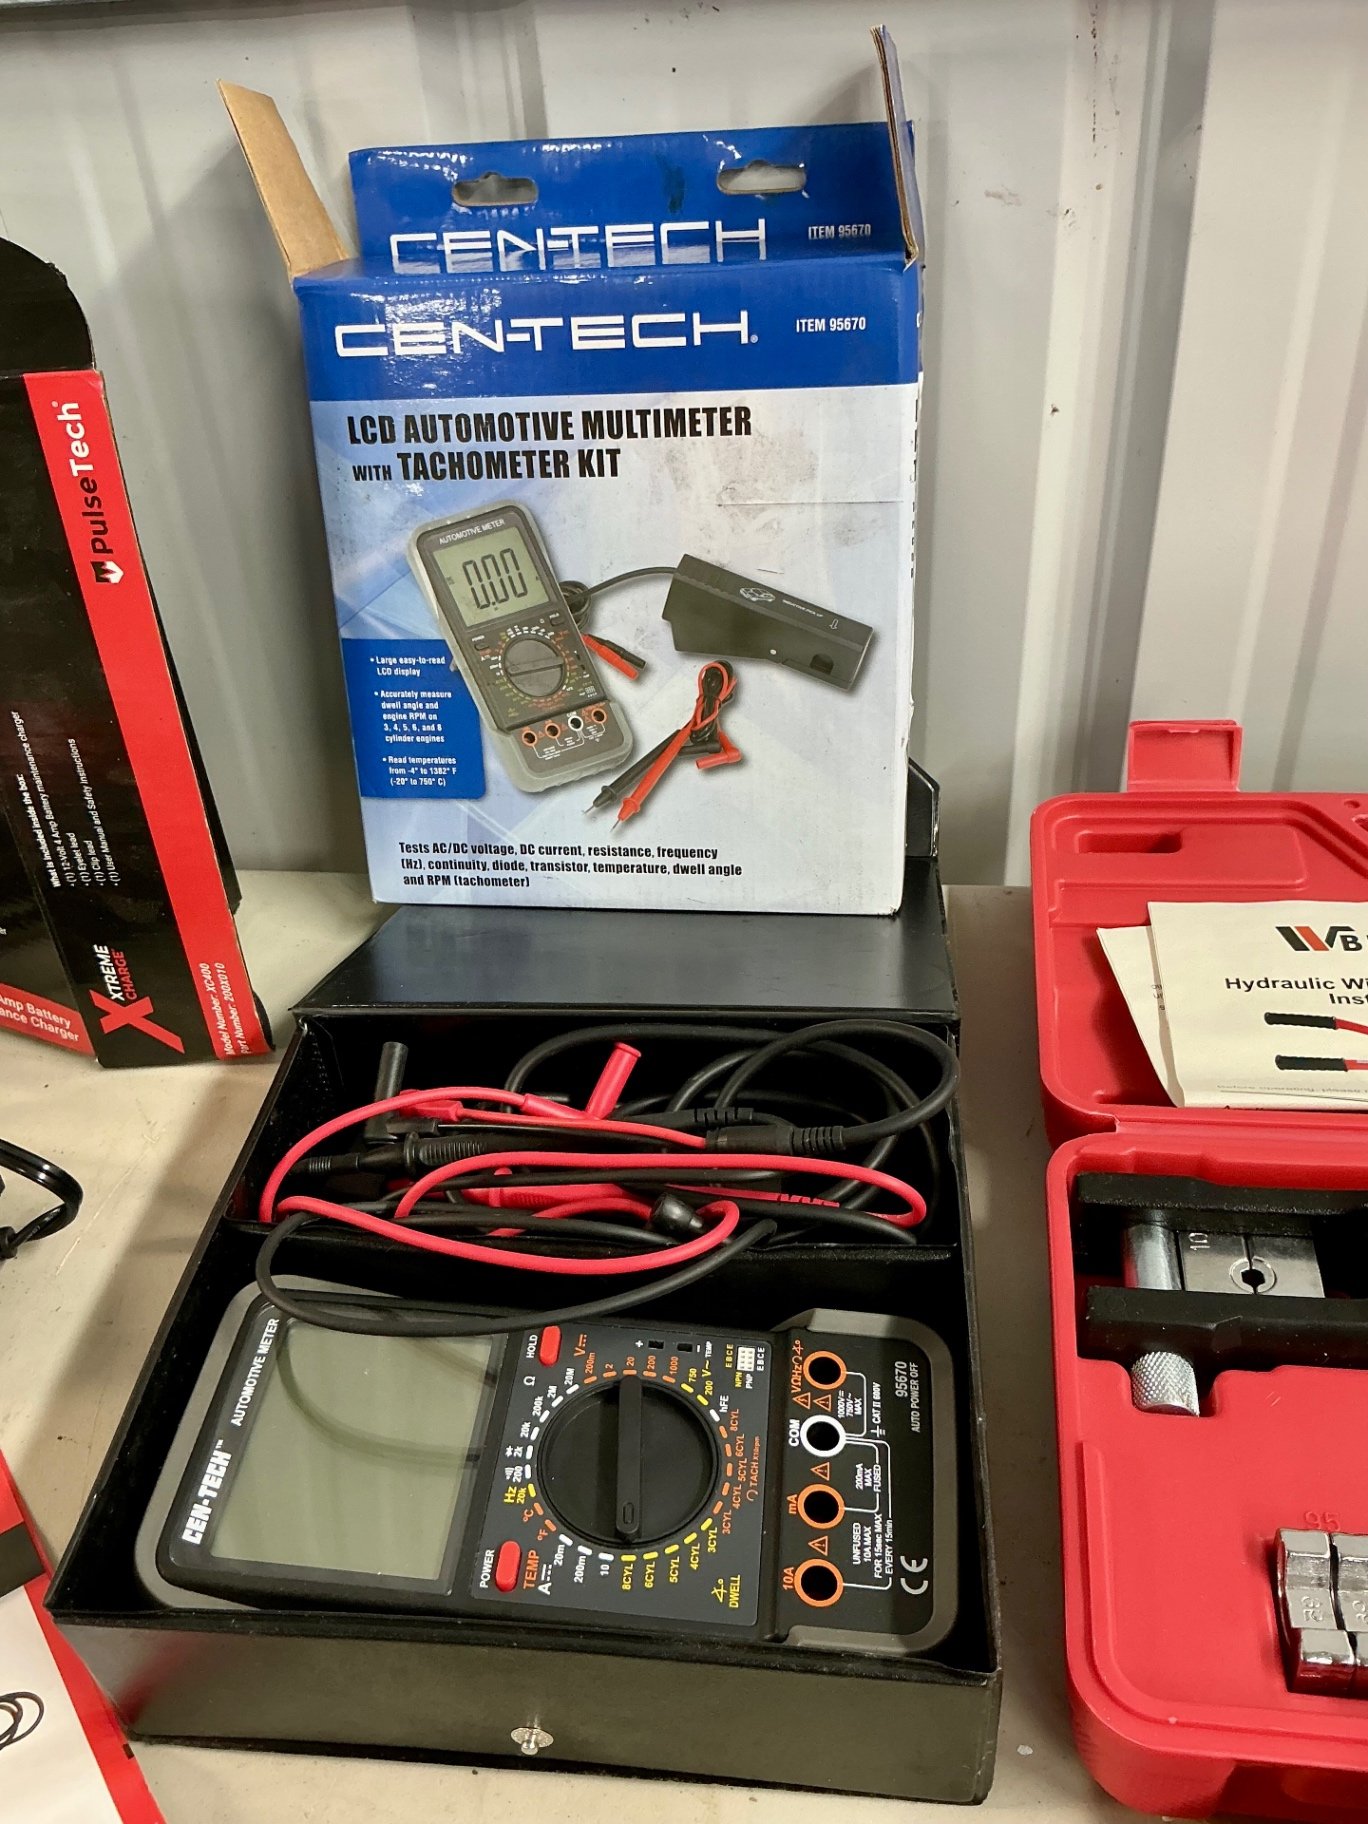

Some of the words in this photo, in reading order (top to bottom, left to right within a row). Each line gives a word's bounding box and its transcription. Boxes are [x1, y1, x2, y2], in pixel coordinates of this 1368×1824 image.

[808, 225, 835, 240] ITEM
[838, 223, 871, 238] 95670
[796, 318, 825, 332] ITEM
[829, 316, 866, 331] 95670
[347, 415, 396, 445] LCD
[404, 411, 574, 444] AUTOMOTIVE
[581, 406, 751, 440] MULTIMETER
[352, 465, 392, 481] WITH
[397, 450, 569, 481] TACHOMETER
[577, 448, 621, 478] KIT
[57, 402, 113, 554] PulseTech
[439, 525, 482, 544] AUTOMOTIVE
[482, 518, 505, 531] METER
[376, 656, 397, 665] Large
[400, 656, 445, 665] easy-to-read
[394, 667, 420, 677] display
[381, 690, 418, 699] Accurately
[381, 701, 401, 709] dwell
[403, 702, 424, 710] angle
[425, 701, 438, 709] and
[11, 711, 28, 741] charger
[383, 713, 407, 721] engine
[385, 735, 414, 743] cylinder
[416, 735, 444, 743] engines
[22, 742, 45, 792] maintenance
[68, 738, 88, 784] Instructions
[388, 755, 407, 763] Read
[408, 756, 456, 765] temperatures
[389, 766, 406, 774] from
[410, 778, 417, 786] to
[22, 792, 33, 805] the
[39, 793, 54, 820] Battery
[82, 785, 97, 810] Safety
[27, 806, 41, 829] inside
[89, 810, 101, 825] and
[49, 821, 60, 838] Amp
[66, 832, 79, 849] lead
[94, 826, 110, 853] Manual
[33, 829, 52, 861] included
[83, 840, 97, 856] lead
[399, 842, 430, 854] Tests
[432, 842, 468, 854] AC/DC
[471, 843, 517, 856] voltage,
[520, 844, 535, 855] DC
[538, 845, 585, 857] current,
[588, 845, 654, 858] resistance,
[657, 846, 717, 860] frequency
[72, 849, 87, 870] Eyelet
[104, 854, 116, 870] User
[401, 858, 425, 870] (Hz),
[428, 858, 489, 872] continuity,
[492, 860, 528, 872] diode,
[530, 860, 590, 873] transistor,
[593, 862, 670, 875] temperature,
[673, 863, 705, 875] dwell
[708, 864, 742, 877] angle
[48, 868, 62, 888] What
[403, 875, 424, 885] and
[427, 875, 450, 886] RPM
[454, 875, 530, 887] (tachometer)
[93, 944, 125, 1001] XTREME
[113, 950, 137, 1000] CHARGE
[199, 962, 217, 993] XC400
[1225, 977, 1335, 992] Hydraulic
[26, 1002, 71, 1027] Battery
[31, 1016, 79, 1042] Charger
[219, 1031, 235, 1055] Model
[526, 1334, 538, 1359] HOLD
[231, 1355, 266, 1426] AUTOMOTIVE
[257, 1318, 280, 1354] METER
[564, 1367, 575, 1385] 20M
[894, 1361, 908, 1398] 95670
[909, 1362, 919, 1377] OFF
[547, 1385, 557, 1398] 2M
[585, 1352, 596, 1374] 200m
[626, 1356, 635, 1366] 20
[647, 1355, 656, 1369] 200
[689, 1368, 697, 1382] 750
[705, 1380, 713, 1395] 200
[720, 1395, 729, 1413] hFE
[910, 1378, 919, 1409] POWER
[854, 1397, 862, 1415] MAX
[872, 1409, 881, 1424] CAT
[788, 1418, 800, 1447] COM
[911, 1410, 920, 1433] AUTO
[736, 1433, 745, 1457] 6CYL
[513, 1466, 523, 1482] 200
[738, 1457, 747, 1481] 5CYL
[750, 1461, 759, 1487] TACH
[855, 1463, 863, 1490] 200mA
[864, 1468, 872, 1487] MAX
[873, 1464, 882, 1492] FUSED
[504, 1486, 517, 1503] Hz
[733, 1484, 742, 1509] 4CYL
[786, 1494, 798, 1515] mA
[722, 1509, 732, 1534] 3CYL
[874, 1513, 883, 1532] MAX
[885, 1519, 893, 1542] 15min
[852, 1522, 861, 1565] UNFUSED
[863, 1525, 872, 1545] MAX
[554, 1544, 565, 1566] 20m
[574, 1555, 586, 1583] 200m
[600, 1564, 609, 1576] 10
[622, 1563, 633, 1590] 8CYL
[644, 1561, 655, 1588] 6CYL
[669, 1556, 680, 1583] 5CYL
[690, 1543, 700, 1570] 4CYL
[708, 1527, 717, 1553] 3CYL
[863, 1546, 872, 1562] 10A
[885, 1544, 893, 1574] EVERY
[480, 1549, 495, 1588] POWER
[523, 1550, 540, 1589] TEMP
[782, 1566, 795, 1590] 10A
[874, 1558, 883, 1578] FOR
[729, 1574, 741, 1608] DWELL
